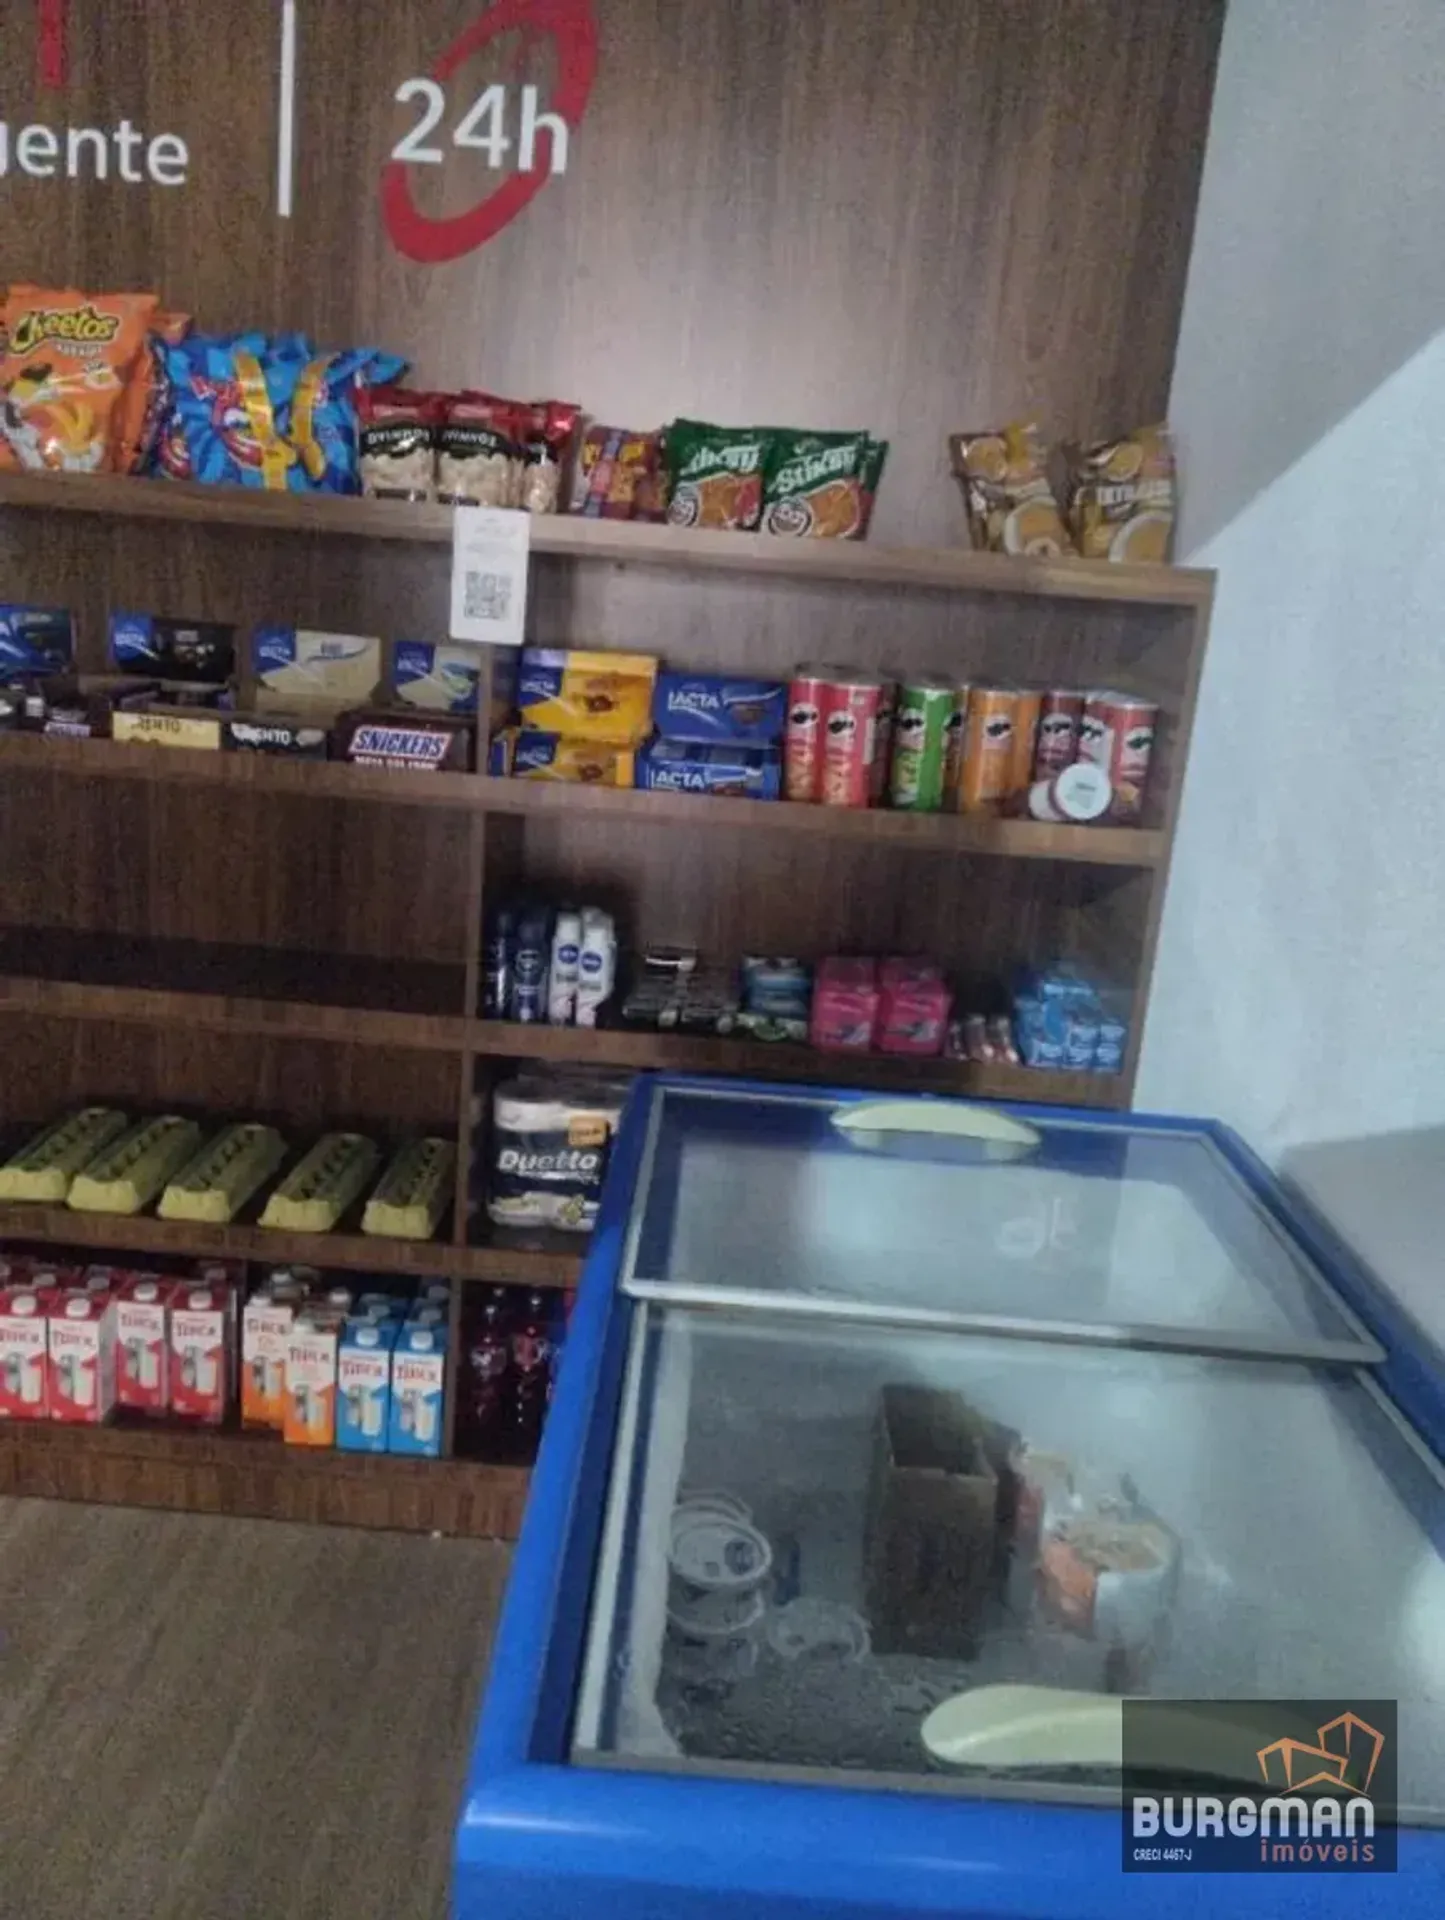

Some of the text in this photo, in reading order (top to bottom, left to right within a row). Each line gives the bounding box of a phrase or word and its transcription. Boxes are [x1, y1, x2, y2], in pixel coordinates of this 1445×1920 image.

[391, 78, 569, 173] 24h
[10, 305, 119, 353] Cheetos
[668, 690, 721, 711] LACTA
[353, 729, 446, 758] SNICKERS
[650, 770, 706, 790] LACTA
[497, 1150, 600, 1172] Duetto
